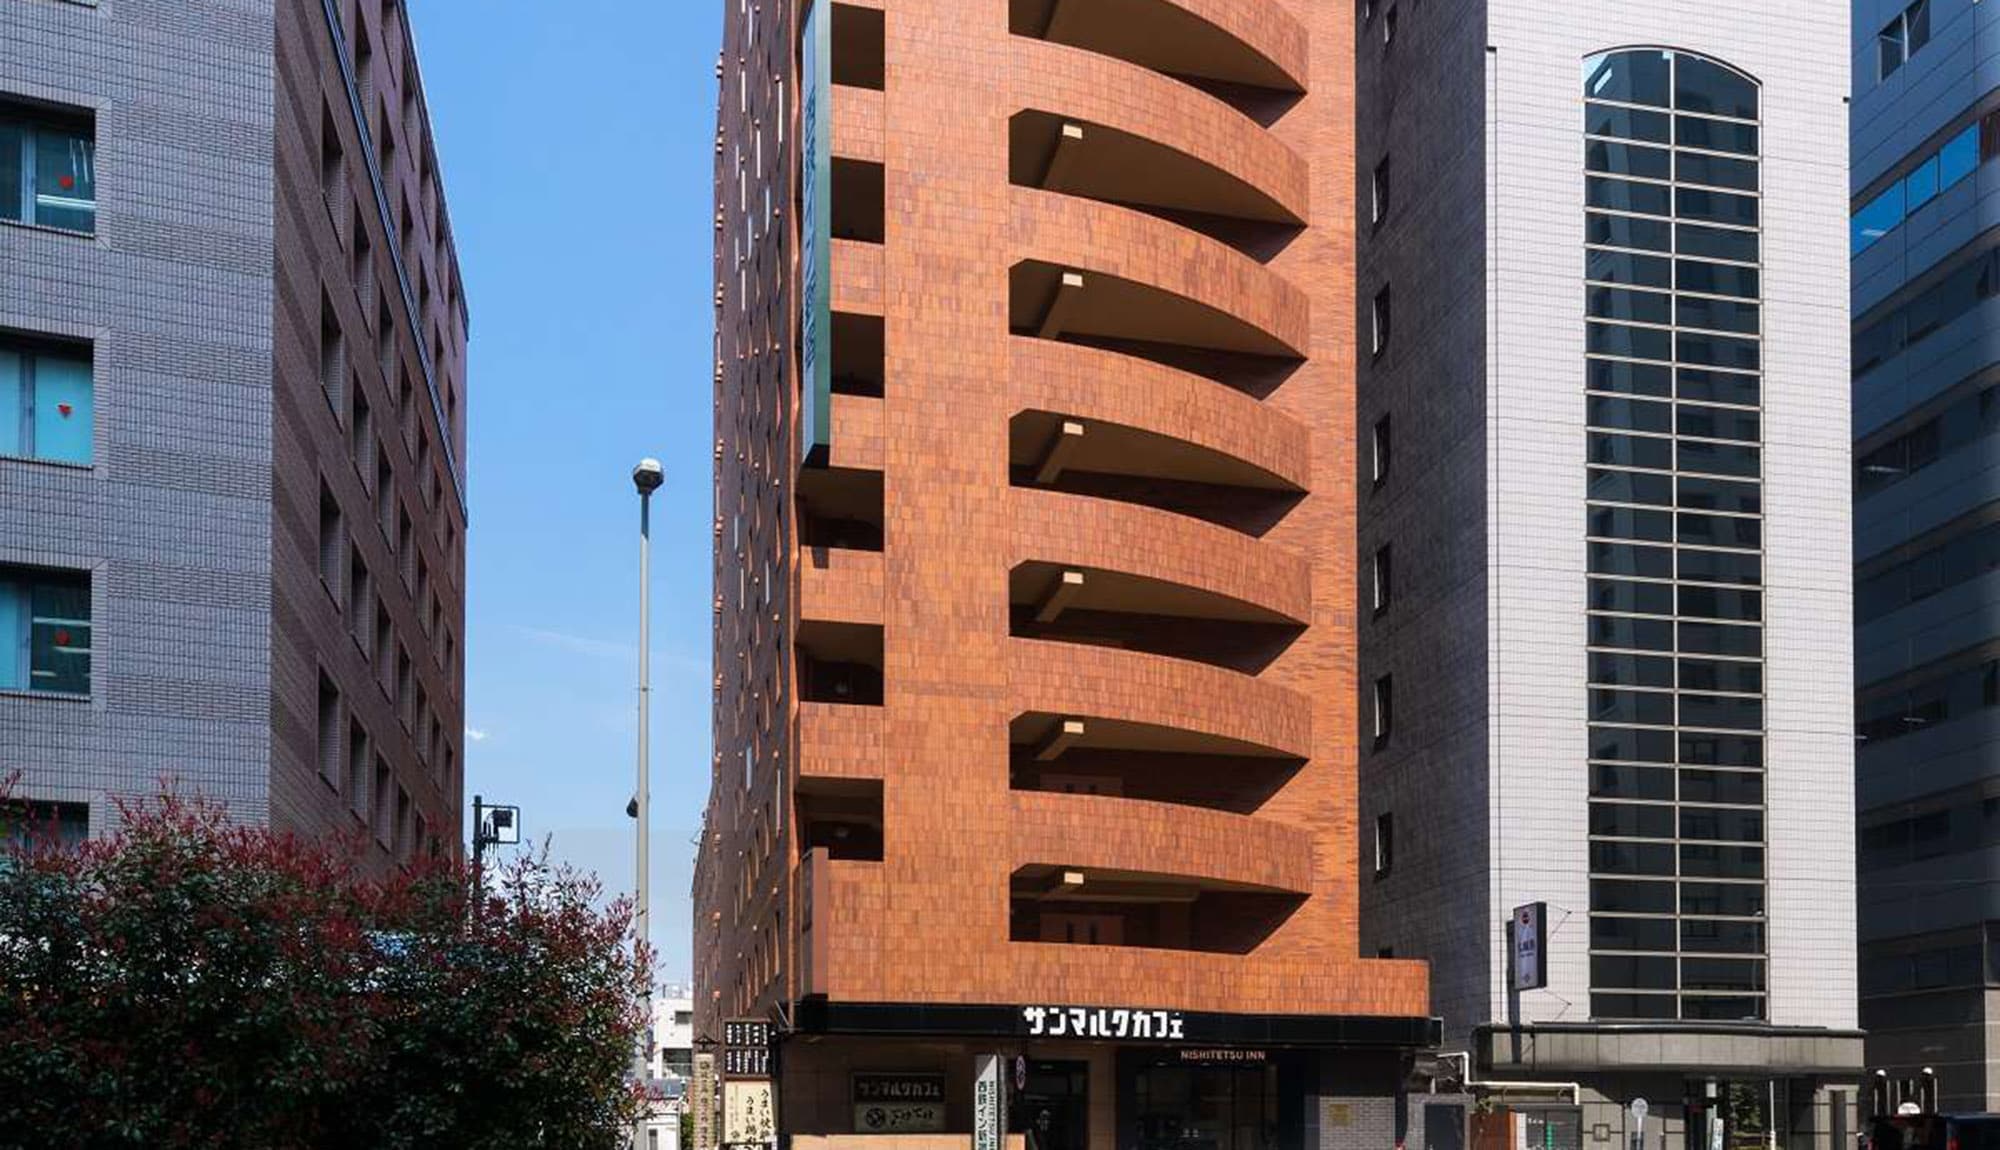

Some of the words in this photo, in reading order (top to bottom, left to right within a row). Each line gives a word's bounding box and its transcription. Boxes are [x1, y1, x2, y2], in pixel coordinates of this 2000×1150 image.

[1024, 1007, 1184, 1039] サンマルクカフェ
[1181, 1050, 1244, 1060] NISHITETSU
[1246, 1050, 1265, 1060] INN
